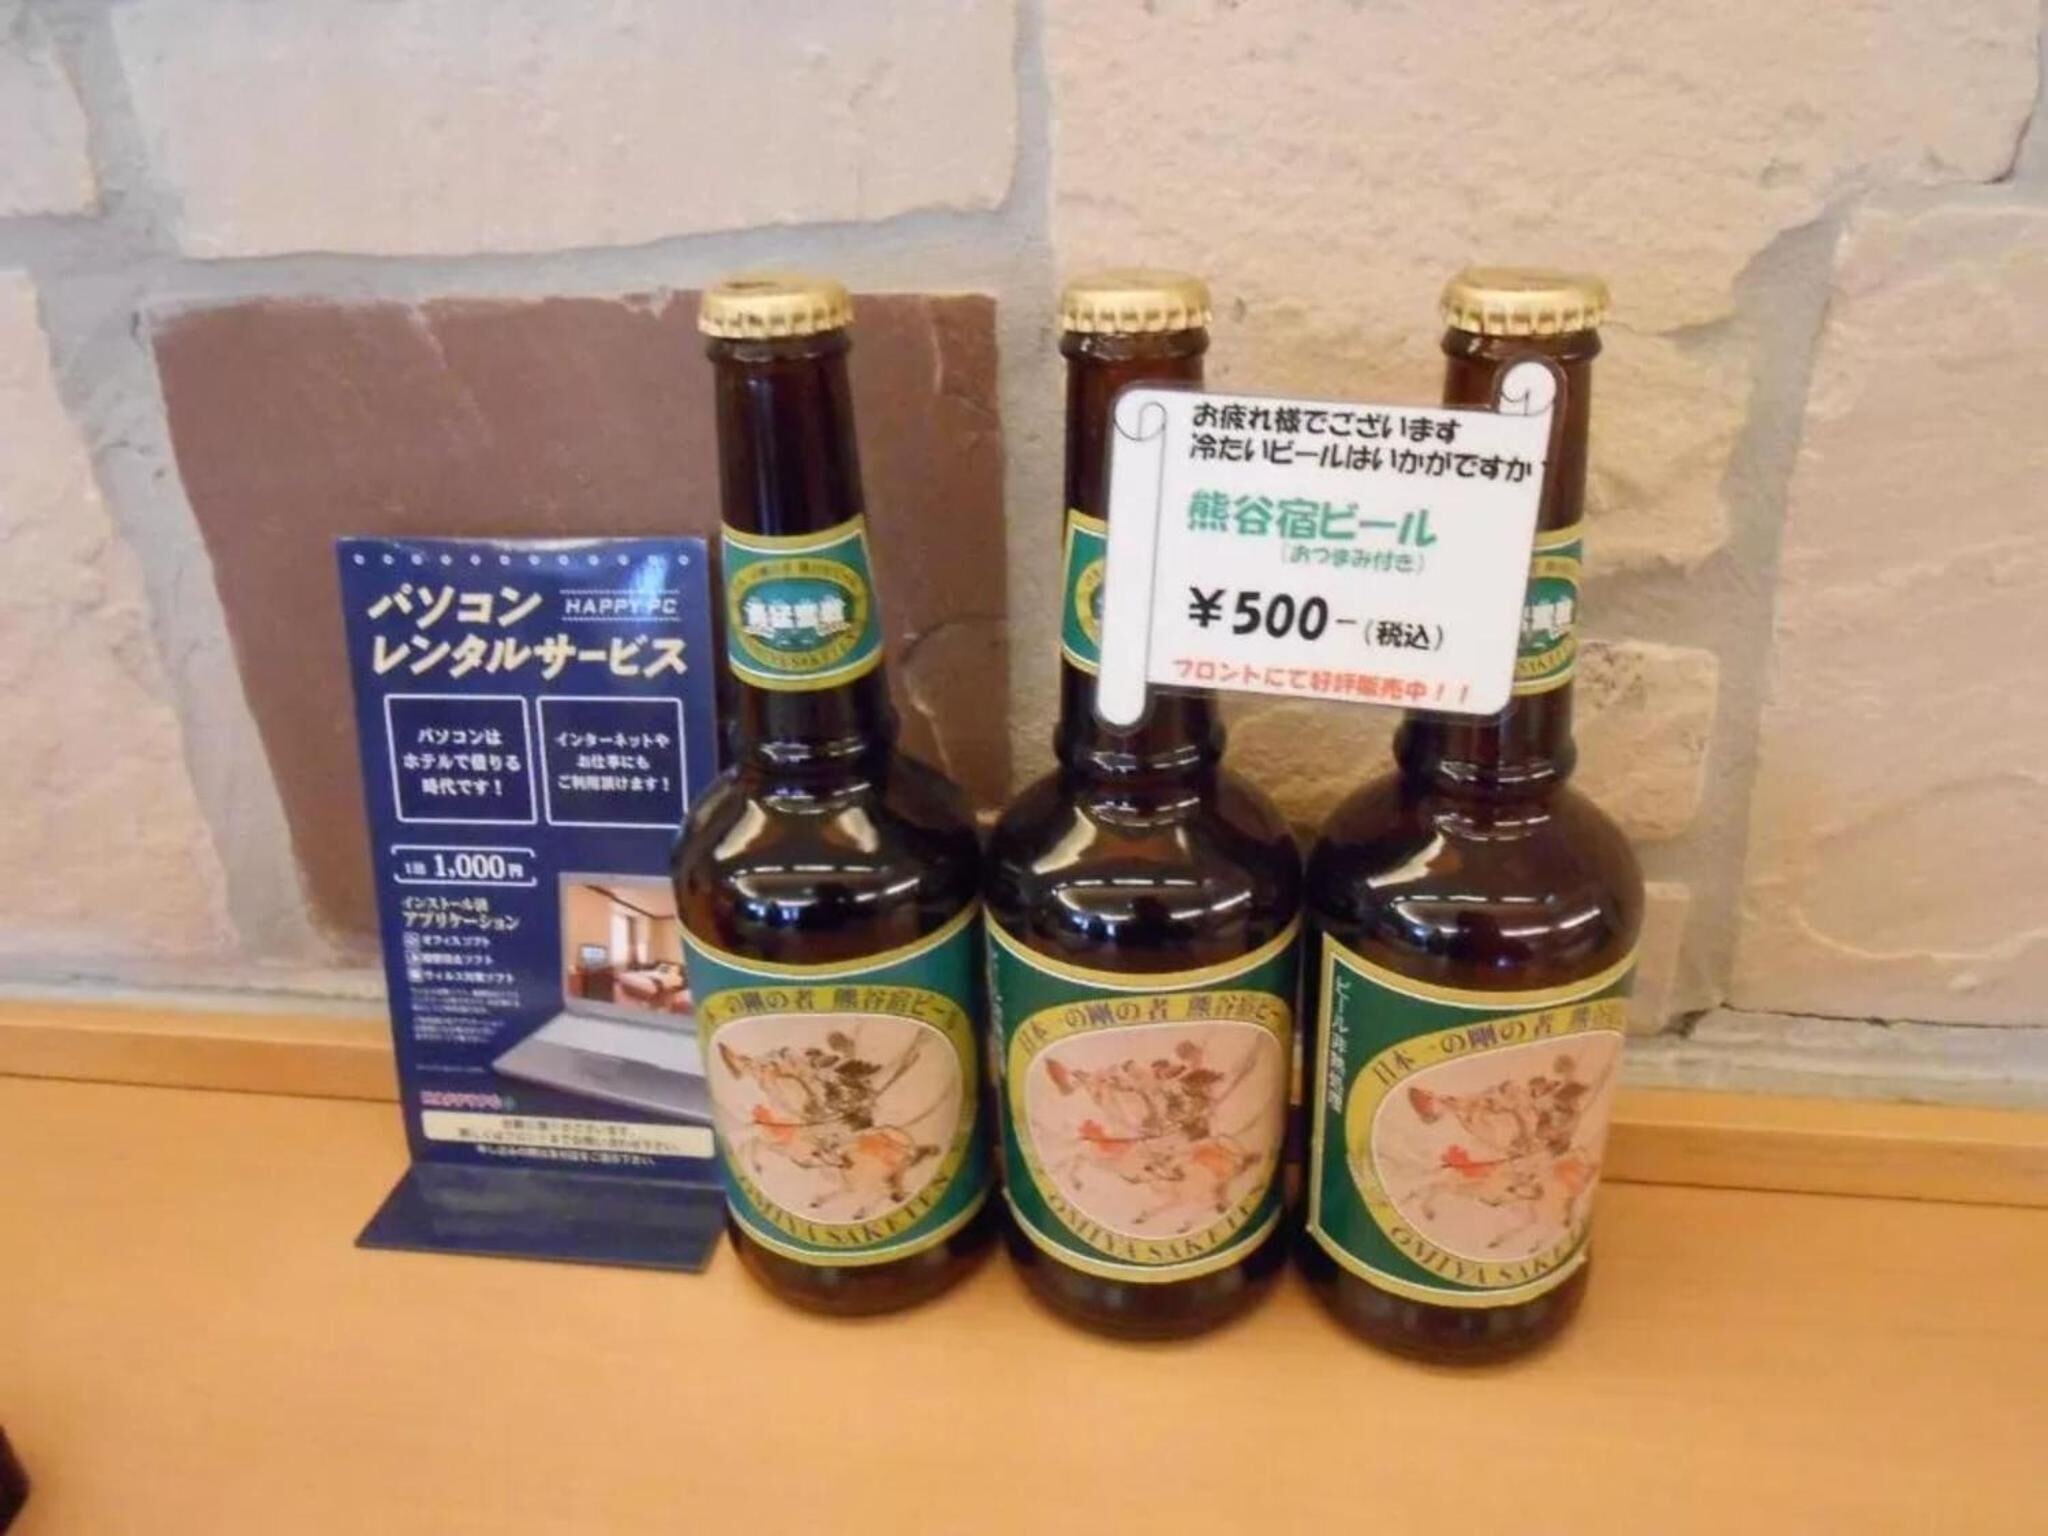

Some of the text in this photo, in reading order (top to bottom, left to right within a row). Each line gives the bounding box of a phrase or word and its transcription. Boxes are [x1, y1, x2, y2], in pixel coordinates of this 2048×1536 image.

[1193, 403, 1462, 444] お疲れ様でございます
[1187, 488, 1438, 548] 熊谷宿ビール
[367, 582, 544, 630] パソコン
[564, 597, 679, 616] HAPPY PC
[372, 633, 688, 680] レンタルサービス
[417, 728, 503, 746] パソコンは
[554, 730, 671, 749] インターネットや
[402, 752, 522, 773] ホテルで借りる
[576, 753, 651, 771] お仕事にも
[420, 776, 503, 796] 時代です!
[433, 853, 525, 880] 1,000円
[402, 911, 521, 931] アプリケーション
